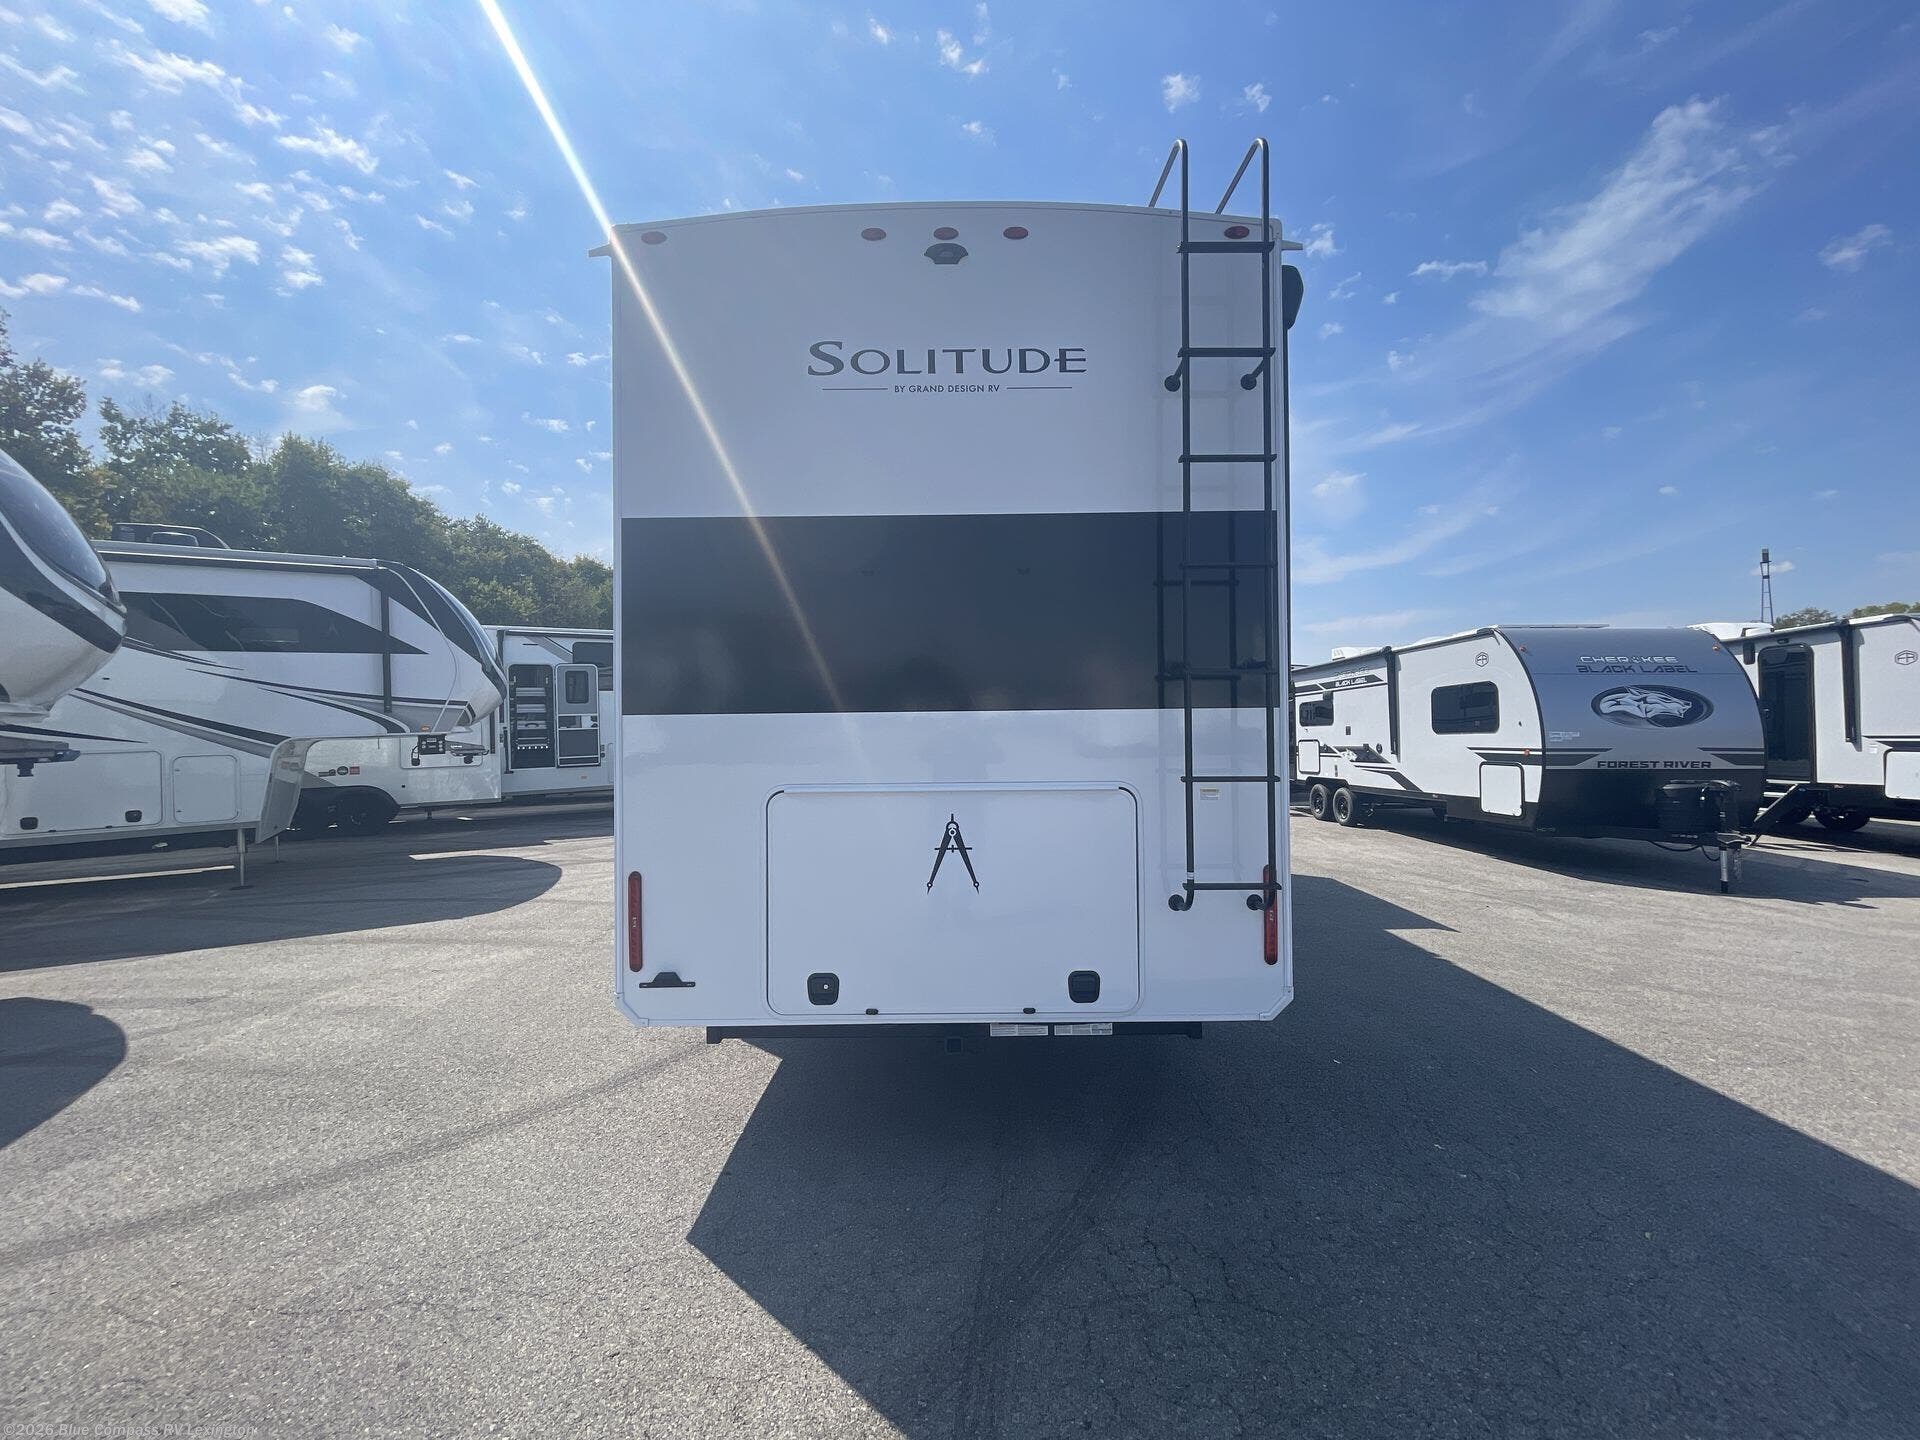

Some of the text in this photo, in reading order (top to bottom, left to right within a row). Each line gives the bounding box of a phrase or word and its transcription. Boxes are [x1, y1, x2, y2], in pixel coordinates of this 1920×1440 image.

[807, 340, 1087, 376] SOLITUDE
[894, 384, 1000, 393] BY GRAND DESIGN RV
[1576, 665, 1698, 673] BLACK LABEL
[1597, 760, 1712, 769] FOREST RIVER
